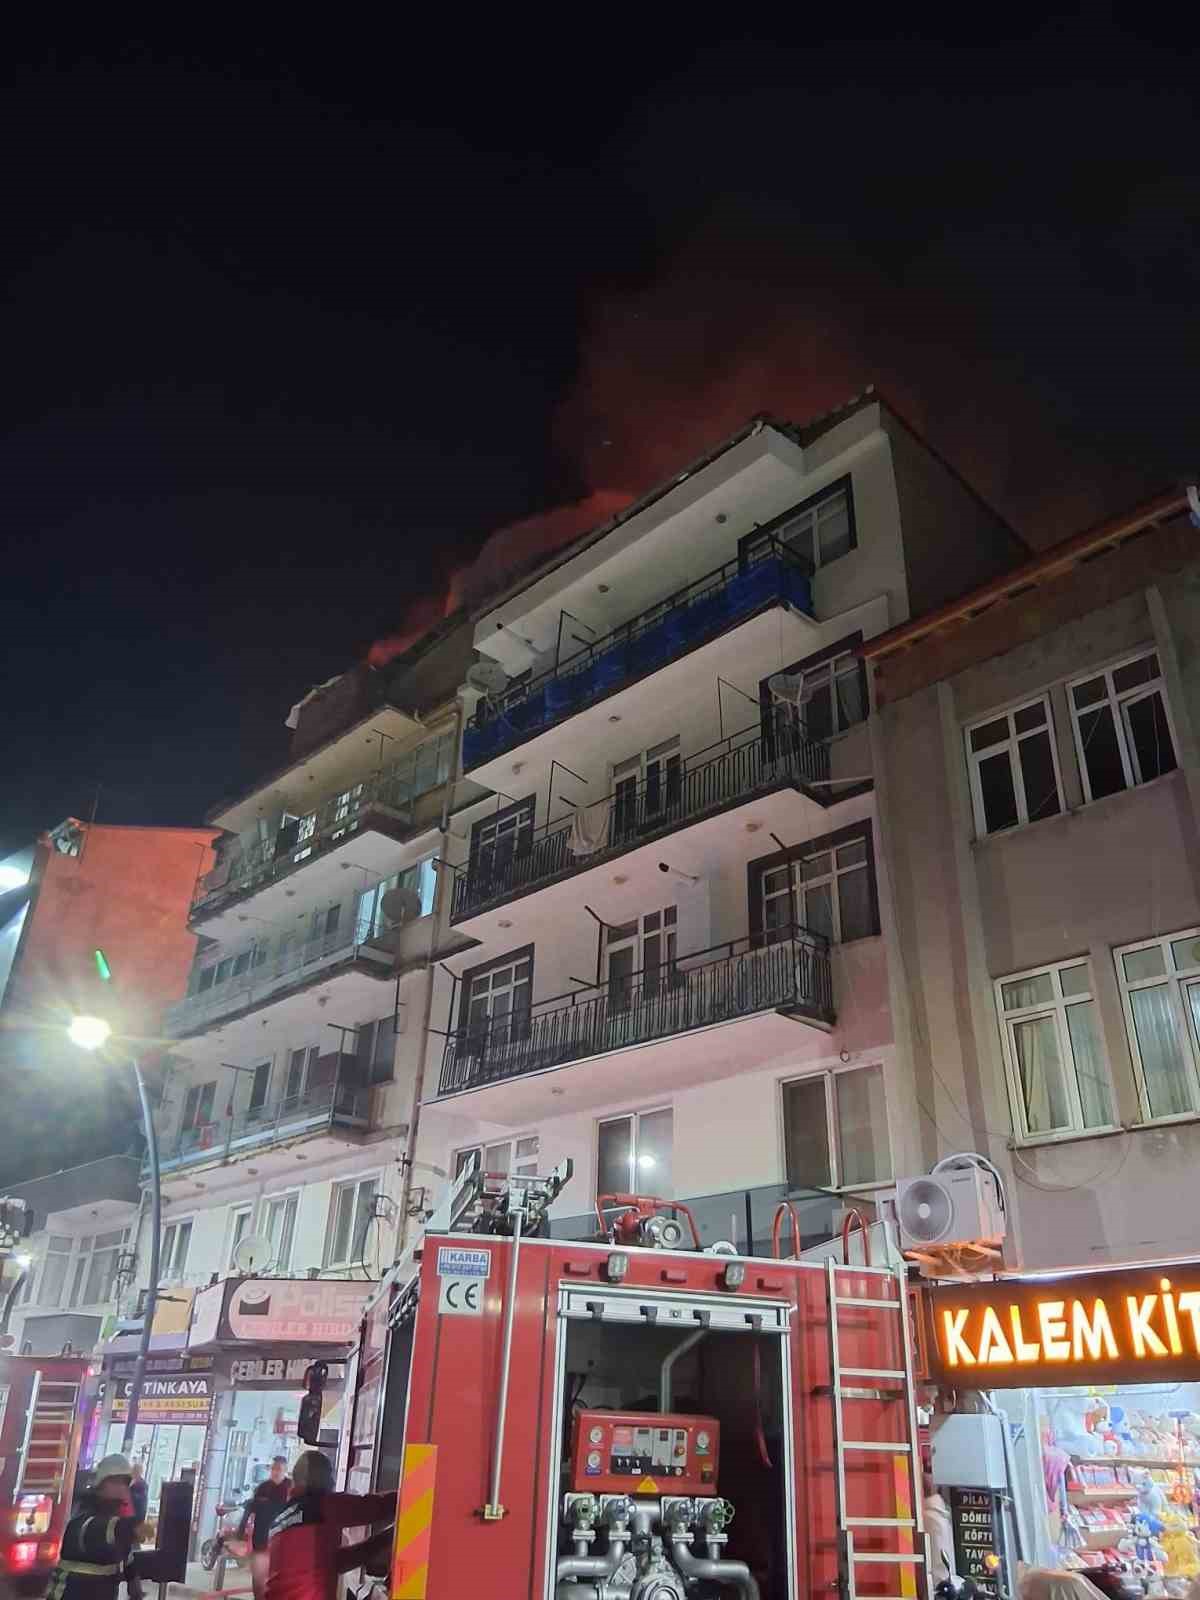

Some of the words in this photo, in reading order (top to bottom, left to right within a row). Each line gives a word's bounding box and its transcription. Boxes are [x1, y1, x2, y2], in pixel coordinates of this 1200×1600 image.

[450, 1252, 486, 1263] KARBA
[446, 1282, 479, 1310] CE
[943, 1298, 1119, 1366] KALEM
[124, 1380, 208, 1397] ÇTİNKAYA
